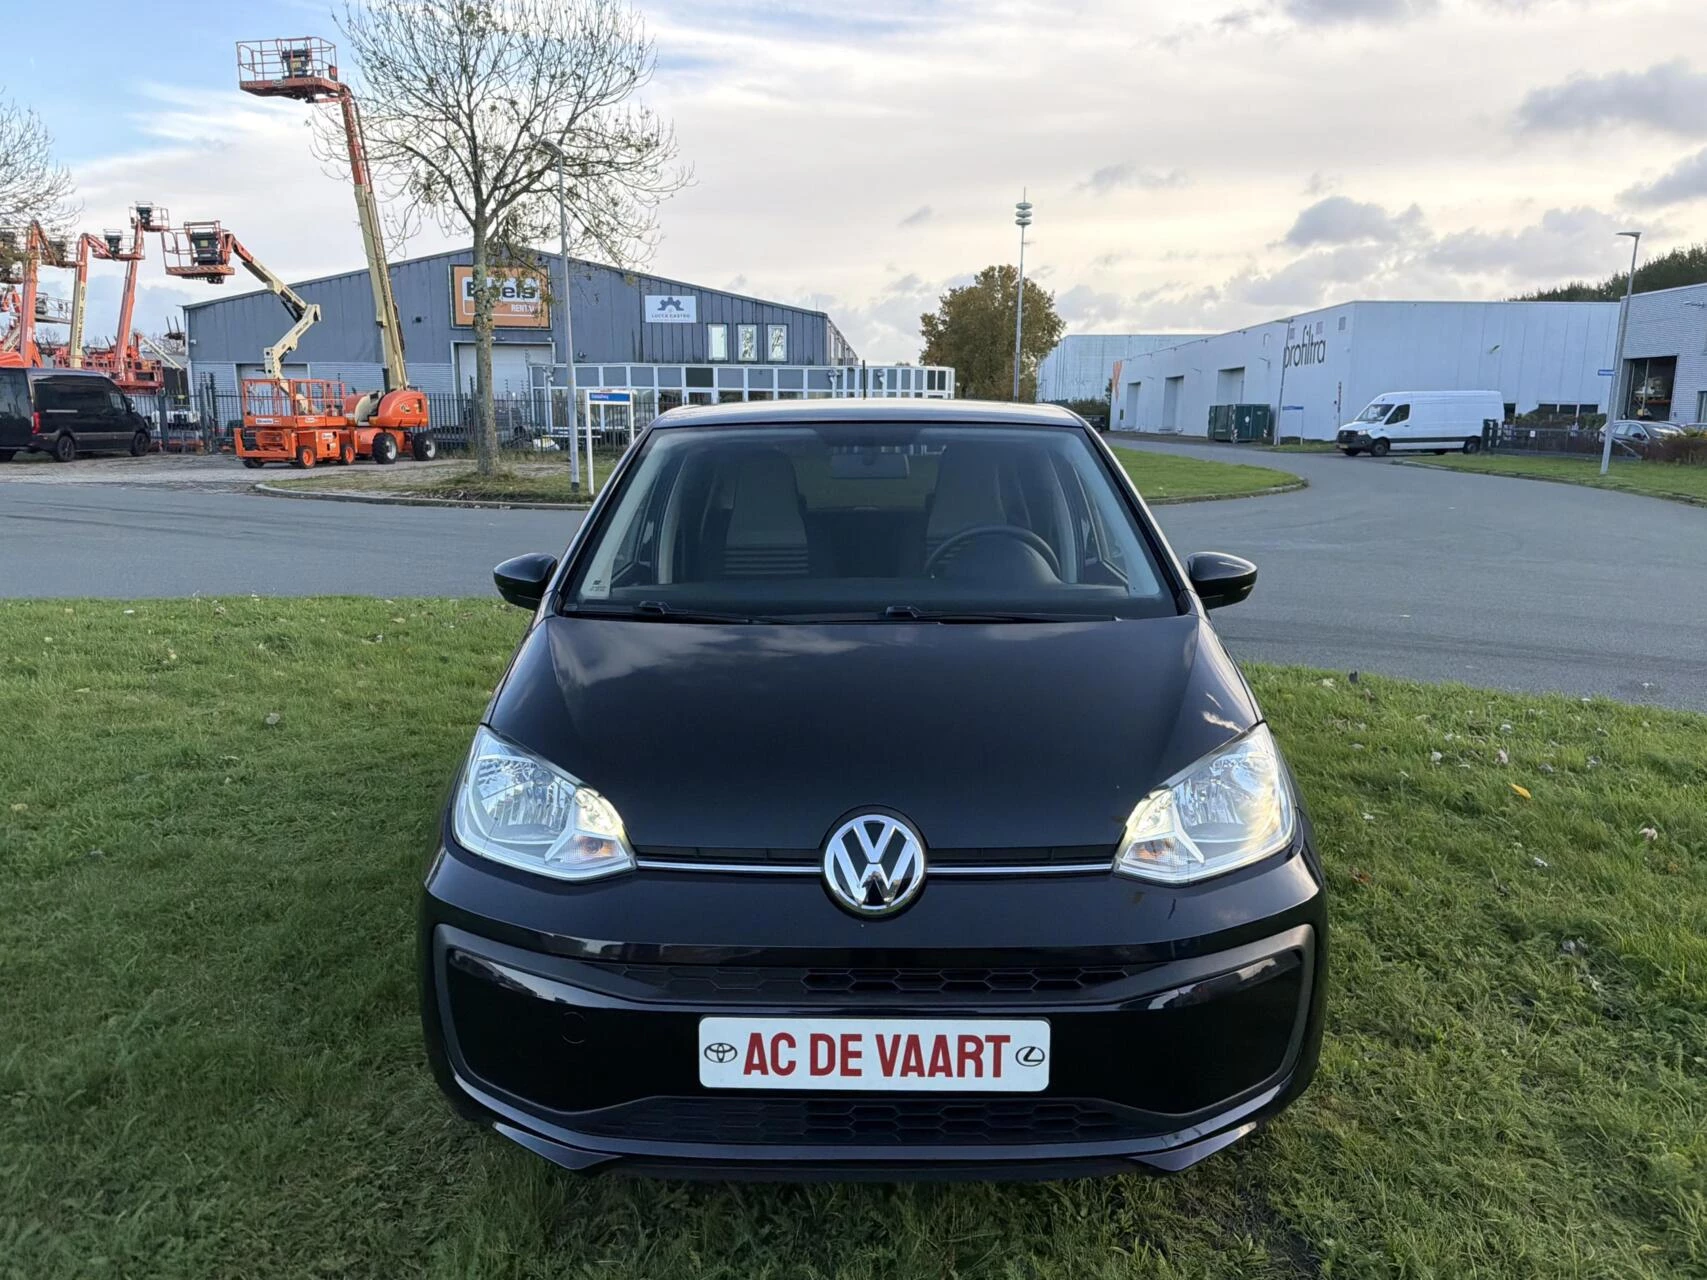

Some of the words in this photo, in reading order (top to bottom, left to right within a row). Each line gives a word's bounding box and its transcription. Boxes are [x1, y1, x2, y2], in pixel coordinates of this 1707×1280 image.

[466, 279, 537, 299] Bels
[1284, 324, 1326, 368] profiltra
[743, 1032, 797, 1076] AC
[810, 1033, 862, 1077] DE
[875, 1034, 1011, 1078] VAART
